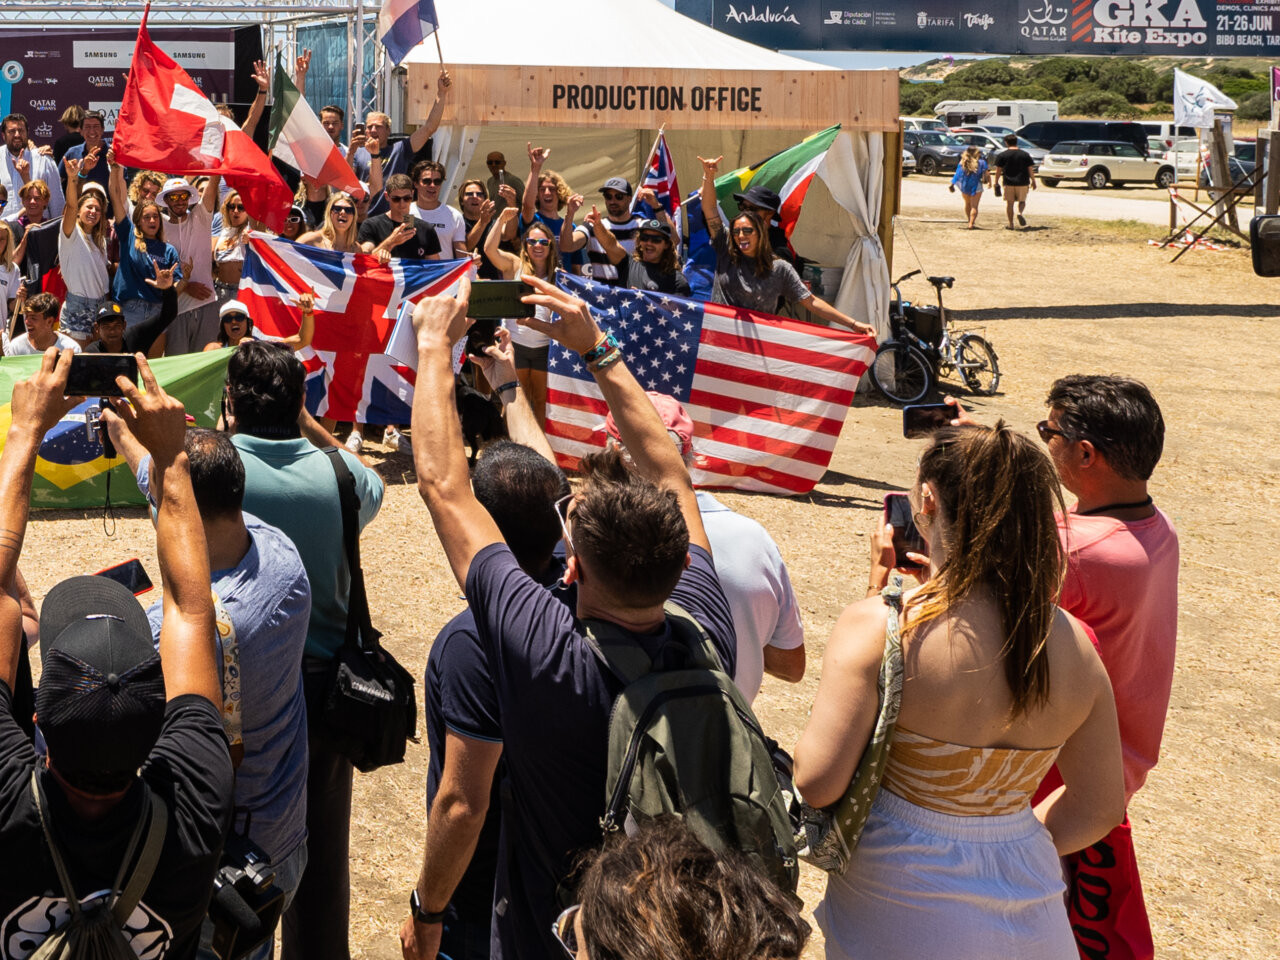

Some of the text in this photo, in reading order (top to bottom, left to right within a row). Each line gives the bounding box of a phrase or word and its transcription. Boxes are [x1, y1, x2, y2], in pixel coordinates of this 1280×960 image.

[725, 3, 801, 25] Andalucía
[927, 18, 955, 26] TARIFA
[963, 12, 995, 31] Tarifa
[1216, 15, 1272, 31] 21-26 JUN
[1020, 26, 1067, 37] QATAR
[1093, 27, 1207, 47] Kite Expo
[1216, 34, 1235, 45] BIBO
[1237, 35, 1265, 46] BEACH,
[88, 75, 115, 84] QATAR
[29, 99, 56, 108] QATAR
[552, 84, 762, 112] PRODUCTION OFFICE
